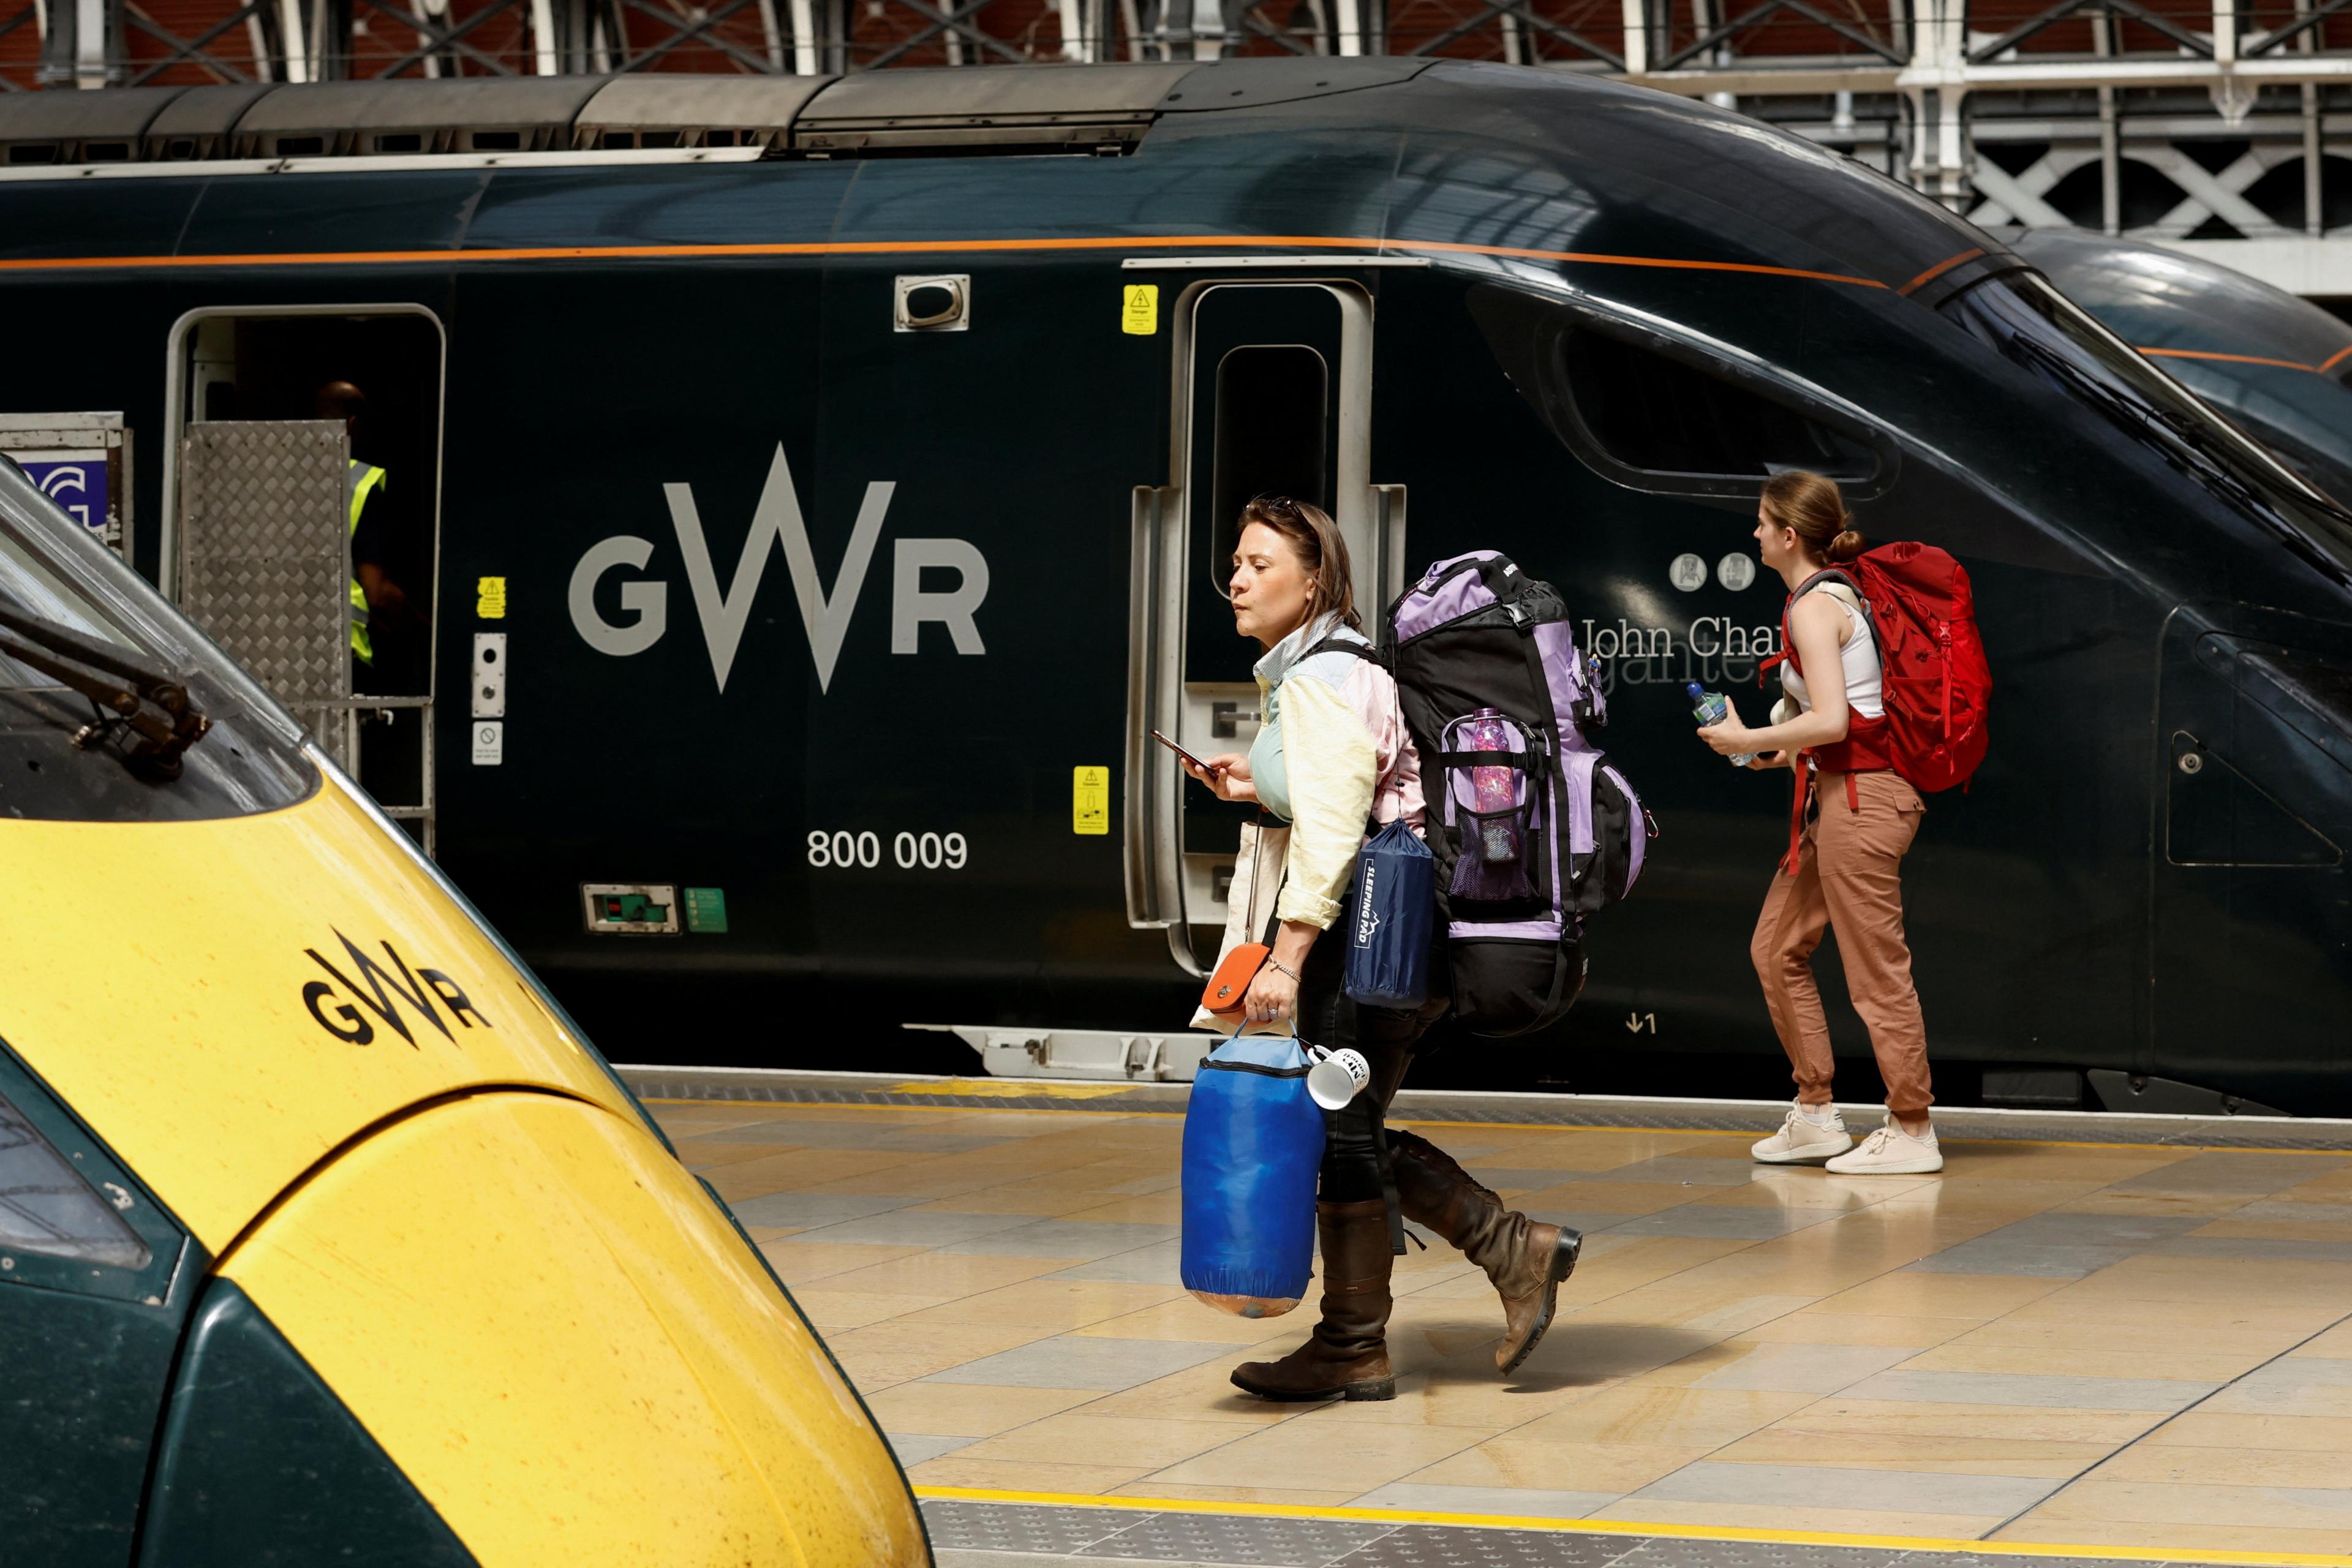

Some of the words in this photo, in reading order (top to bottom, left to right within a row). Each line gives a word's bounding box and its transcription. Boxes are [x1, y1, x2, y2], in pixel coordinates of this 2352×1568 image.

[568, 440, 990, 696] GWR
[1574, 618, 1675, 659] John
[807, 830, 881, 868] 800
[894, 831, 968, 869] 009
[1360, 866, 1375, 918] SLEEPING
[1359, 919, 1371, 943] PAD
[302, 922, 493, 1052] GWR
[1645, 1012, 1656, 1034] 1
